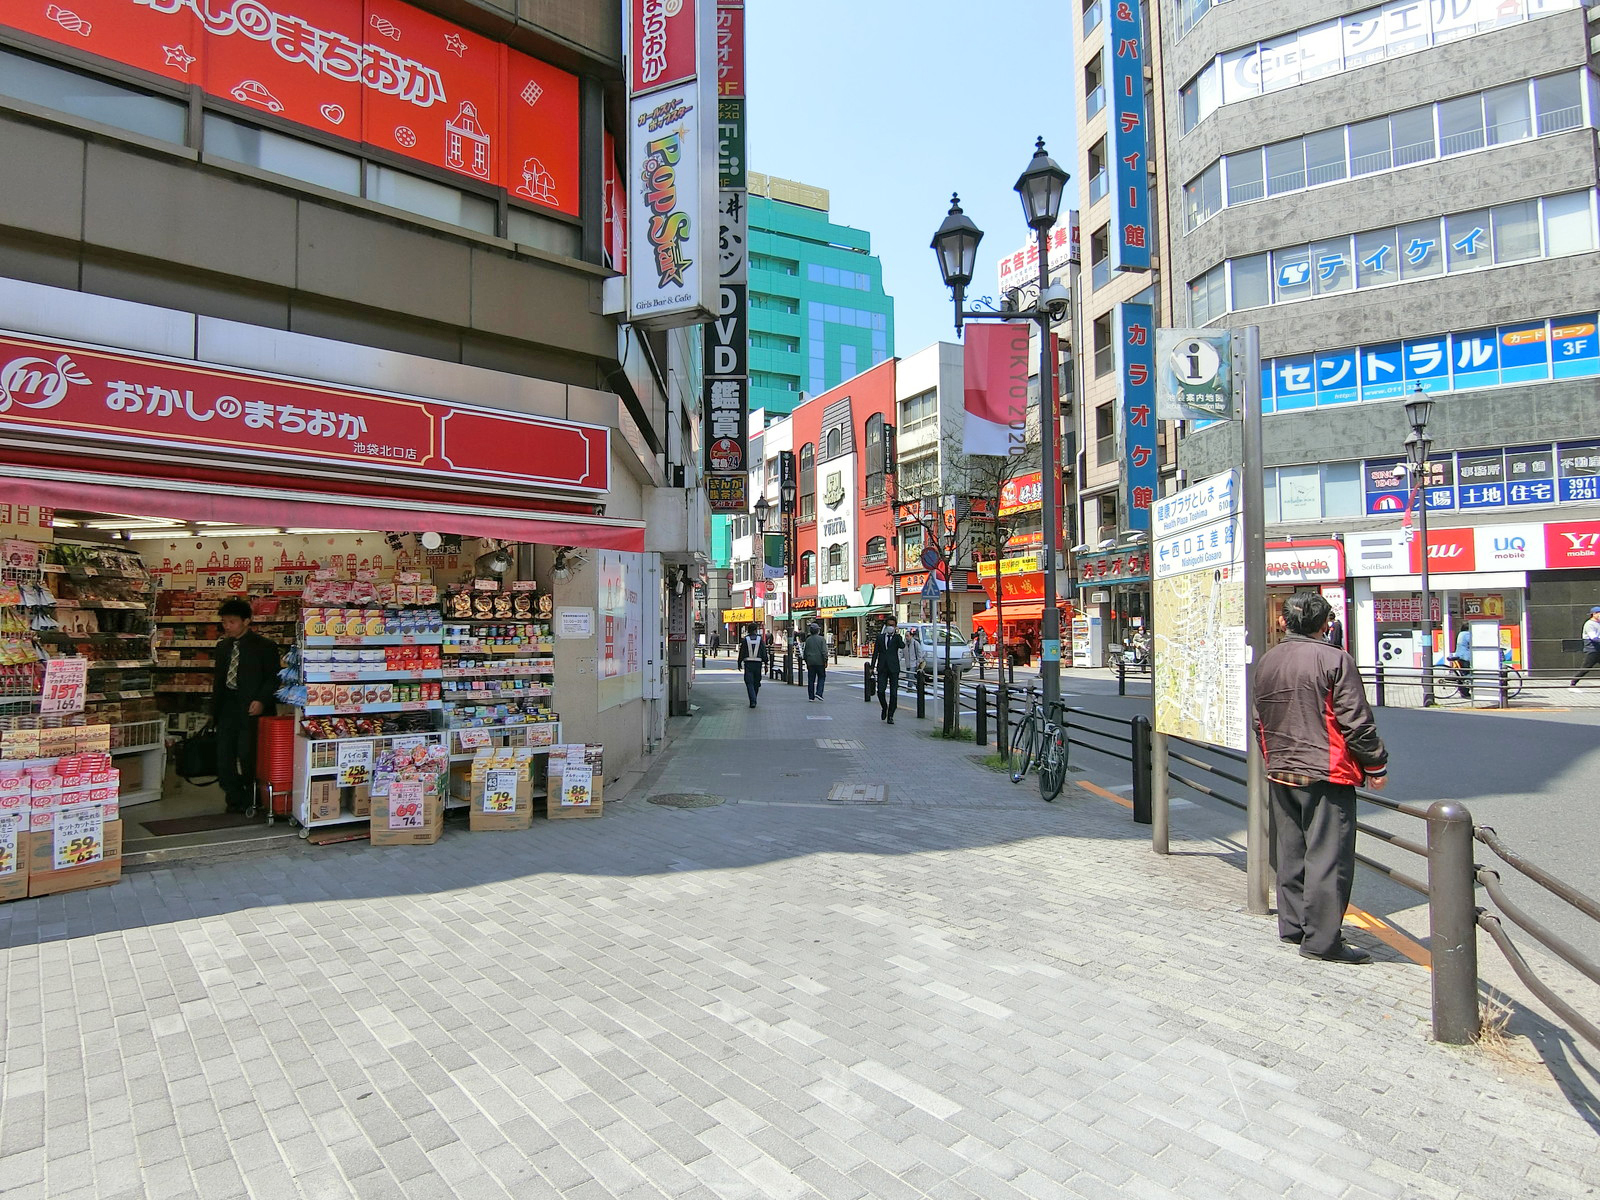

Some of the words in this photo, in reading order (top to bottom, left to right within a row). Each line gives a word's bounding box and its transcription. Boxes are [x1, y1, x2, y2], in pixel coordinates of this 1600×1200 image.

[132, 0, 447, 108] しのまちおか
[714, 287, 738, 374] DVD
[1510, 326, 1587, 344] カードローン
[1563, 340, 1588, 356] 3F
[1279, 336, 1494, 392] セントラル
[106, 379, 368, 441] おかしのまちおか
[710, 380, 741, 439] 鑑賞
[1128, 323, 1155, 510] カラオケ館
[1007, 405, 1028, 457] 2020
[353, 441, 418, 461] 池袋北口店
[1569, 478, 1597, 489] 3971
[1157, 486, 1215, 522] 健康プラザとしま
[1463, 488, 1502, 505] 土地
[1510, 484, 1551, 501] 住宅
[1569, 489, 1597, 500] 2291
[1171, 525, 1234, 558] 西口五差路
[1493, 536, 1525, 552] UQ
[1494, 551, 1526, 560] mobile
[1566, 549, 1596, 557] mobile
[1266, 562, 1289, 572] ape
[1290, 559, 1329, 570] studio
[1361, 563, 1394, 571] SoftBank
[1374, 599, 1439, 610] 内有中国员
